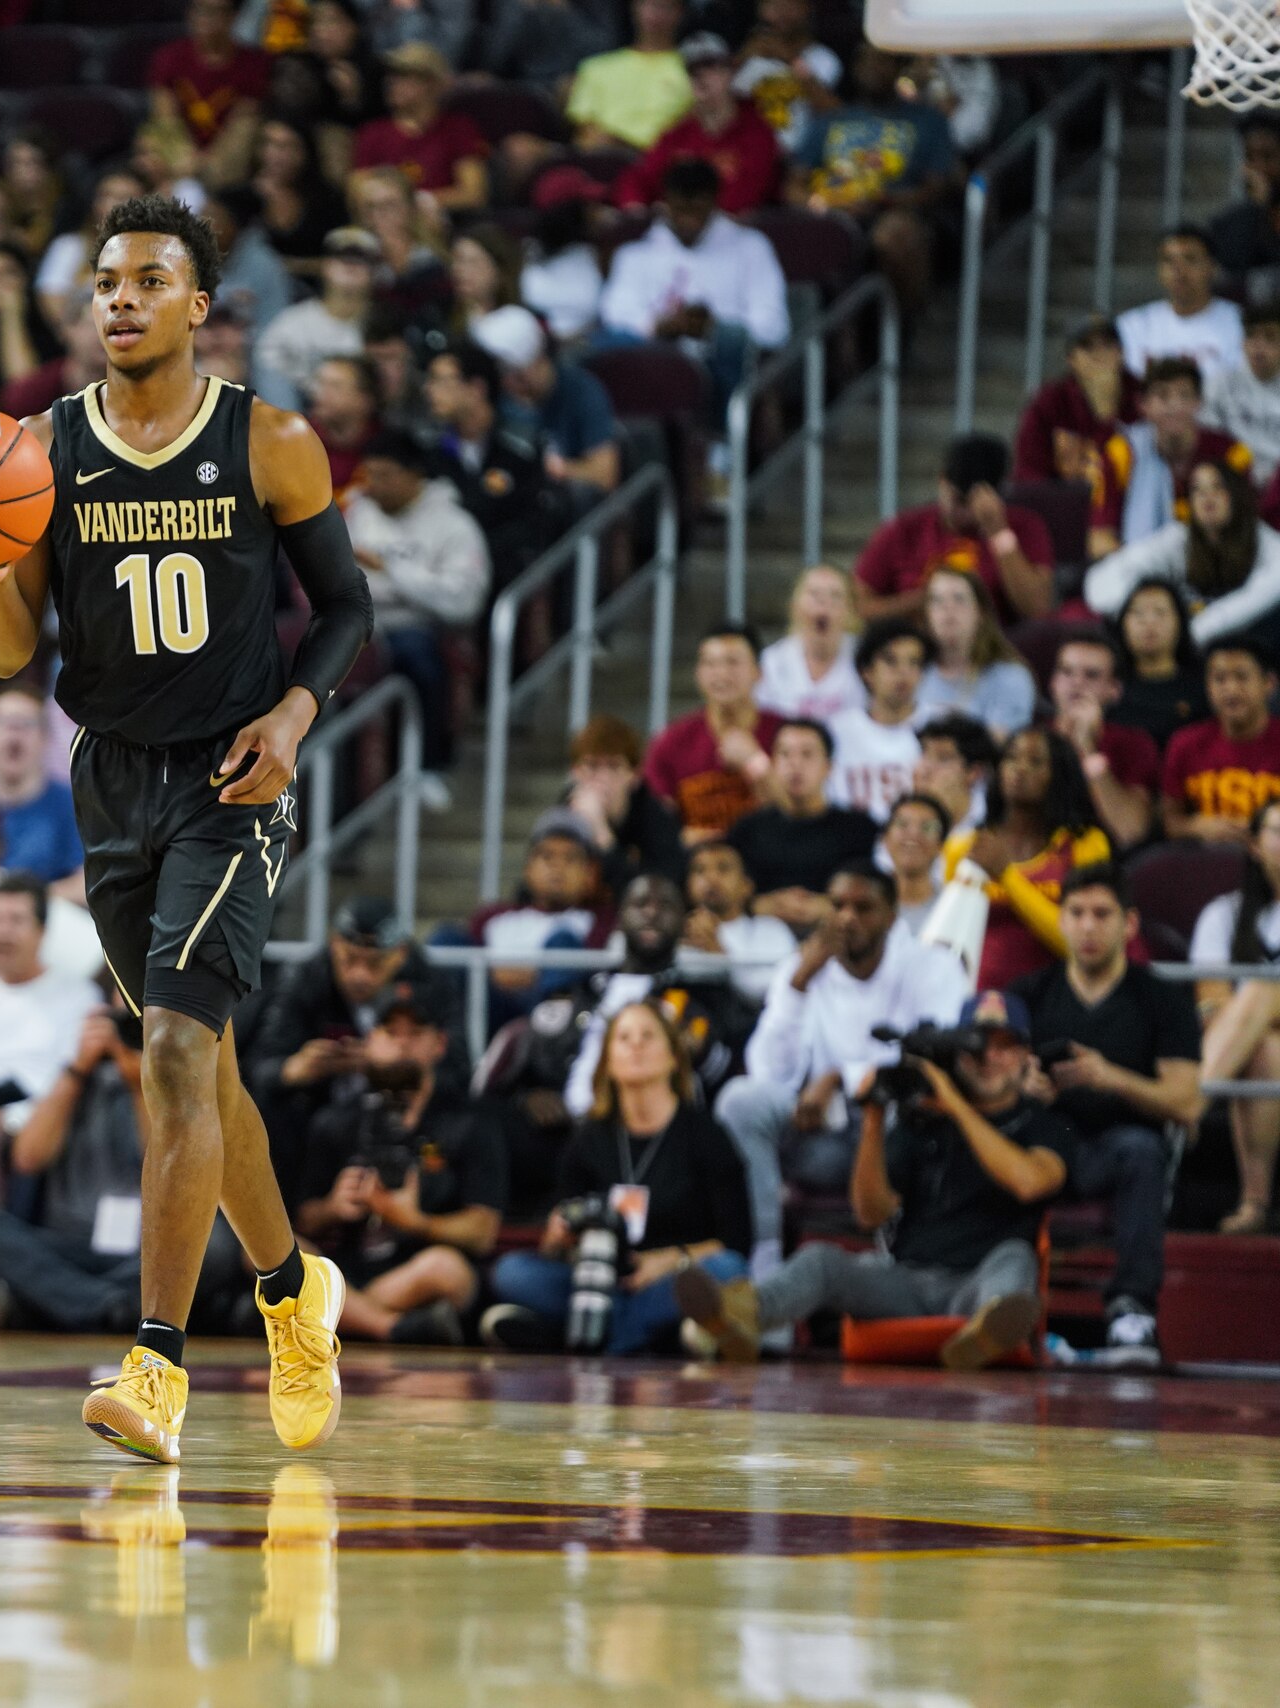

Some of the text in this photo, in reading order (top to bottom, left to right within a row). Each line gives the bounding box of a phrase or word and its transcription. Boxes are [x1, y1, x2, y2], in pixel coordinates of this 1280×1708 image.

[199, 463, 217, 481] SEC
[73, 496, 236, 543] VANDERBILT
[114, 552, 210, 655] 10
